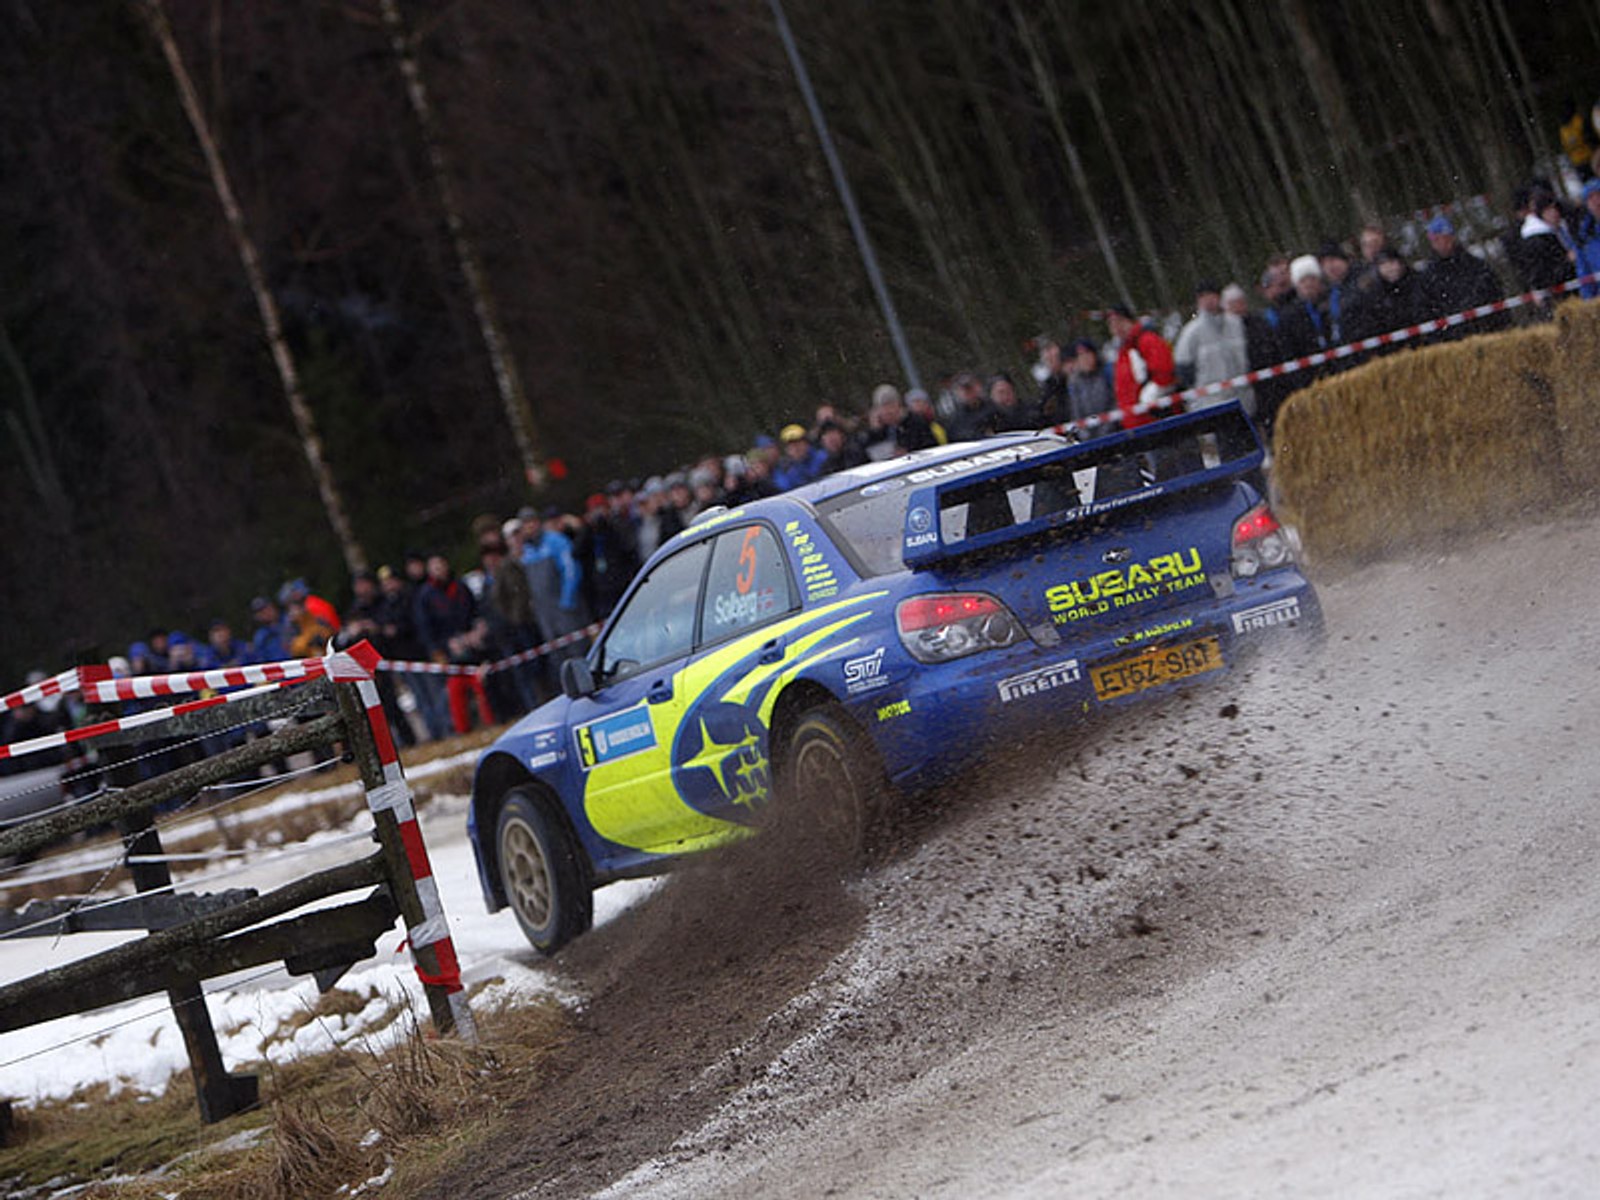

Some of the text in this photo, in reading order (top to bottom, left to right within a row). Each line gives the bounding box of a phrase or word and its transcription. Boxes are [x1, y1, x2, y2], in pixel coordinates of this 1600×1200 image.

[736, 525, 762, 594] 5
[1045, 547, 1202, 612] SUBARU
[714, 591, 758, 623] Solberg
[1053, 573, 1207, 625] WORLD RALLY TEAM
[1232, 597, 1300, 634] PIRELLI
[998, 660, 1081, 702] PIRELLI
[580, 727, 596, 766] 5
